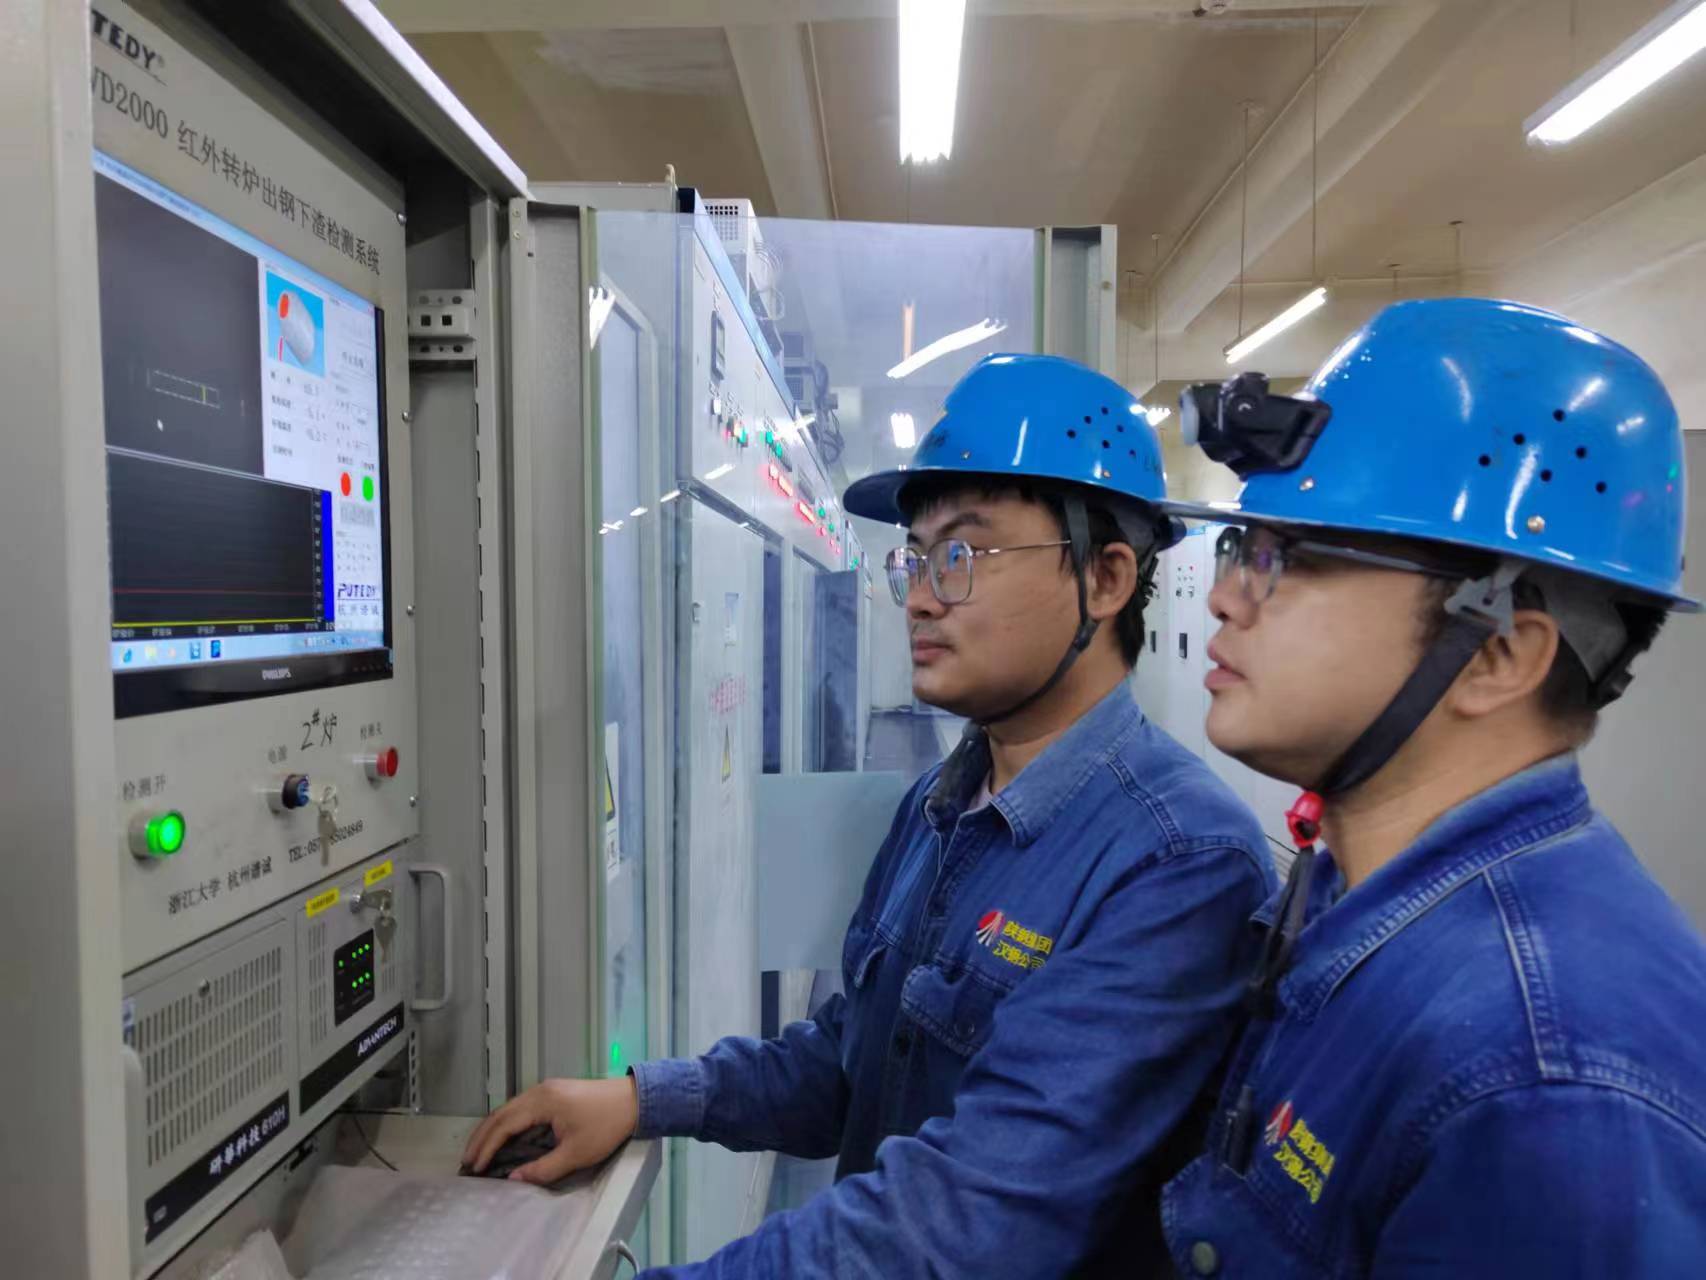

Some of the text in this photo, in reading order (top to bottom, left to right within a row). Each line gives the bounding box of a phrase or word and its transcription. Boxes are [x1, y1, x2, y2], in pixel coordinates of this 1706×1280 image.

[177, 119, 381, 275] 红外转炉出钢下渣检测系统
[337, 583, 376, 598] PUTEDY
[261, 667, 292, 681] PHILIPS
[121, 774, 166, 801] 检测开
[168, 878, 222, 915] 浙江大学
[357, 1016, 397, 1057] ADVANTECH
[208, 1124, 261, 1176] 研华科技
